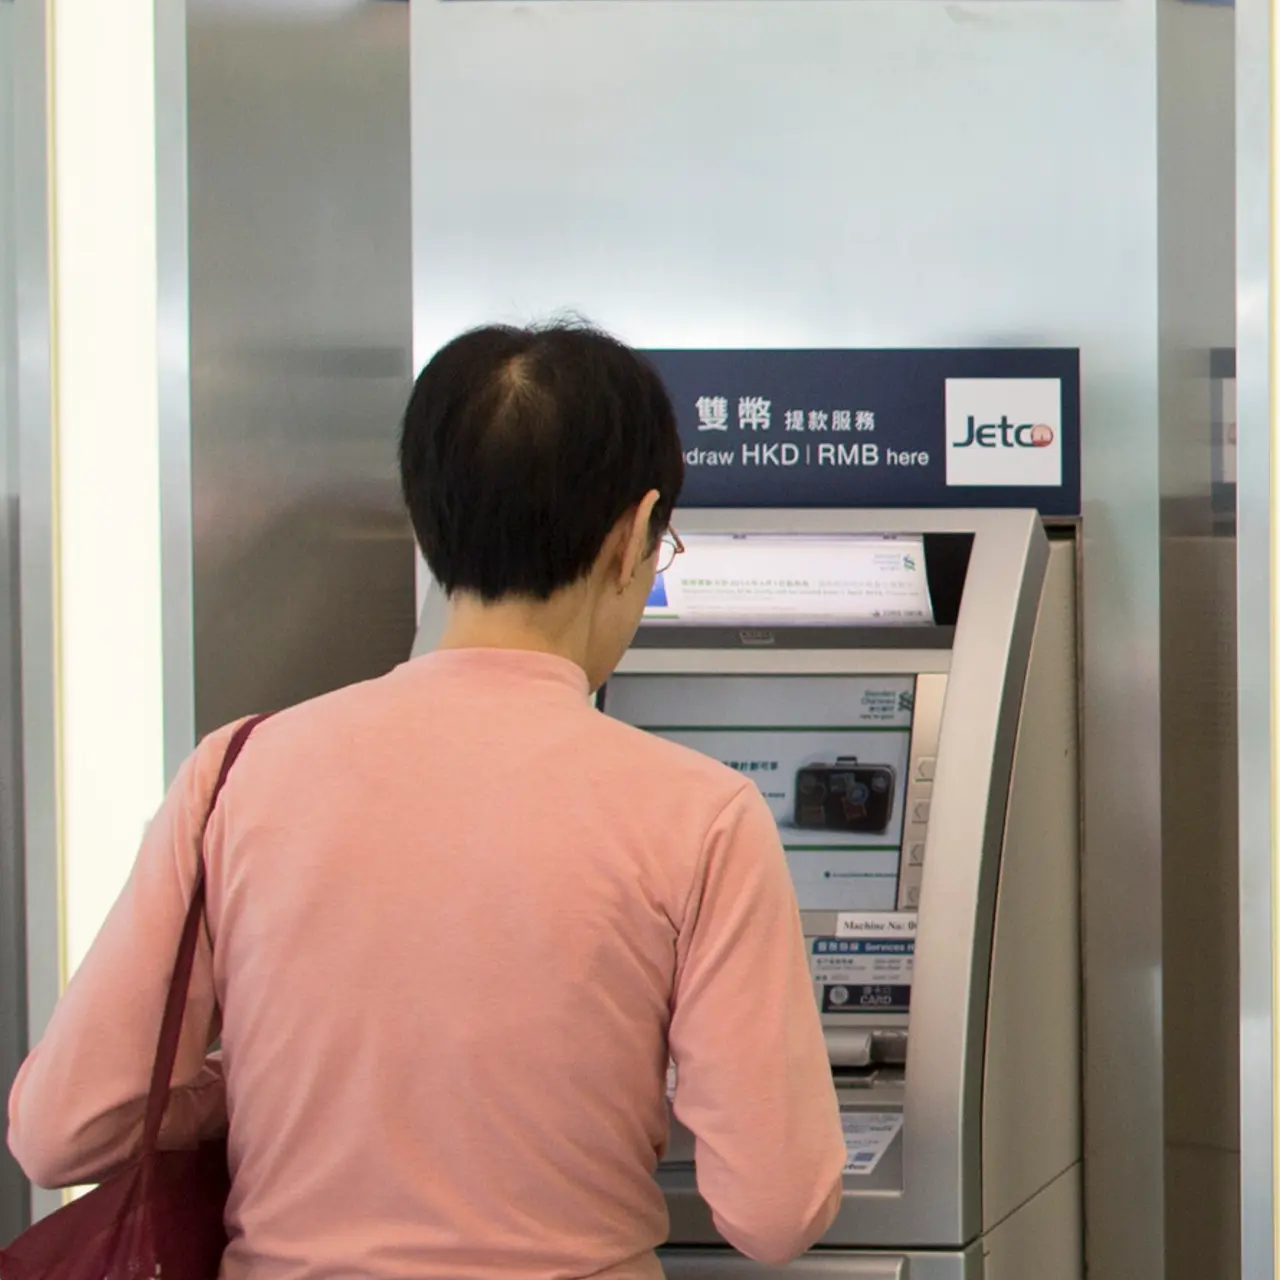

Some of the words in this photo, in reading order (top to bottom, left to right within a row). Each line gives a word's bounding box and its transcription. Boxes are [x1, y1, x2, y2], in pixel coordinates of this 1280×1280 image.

[695, 396, 772, 431] 雙幣
[784, 410, 876, 431] 提款服務
[741, 443, 799, 466] HKD
[817, 443, 880, 466] RMB
[886, 447, 930, 466] here
[844, 920, 886, 930] Machine
[865, 942, 905, 953] Services
[859, 996, 893, 1006] CARD
